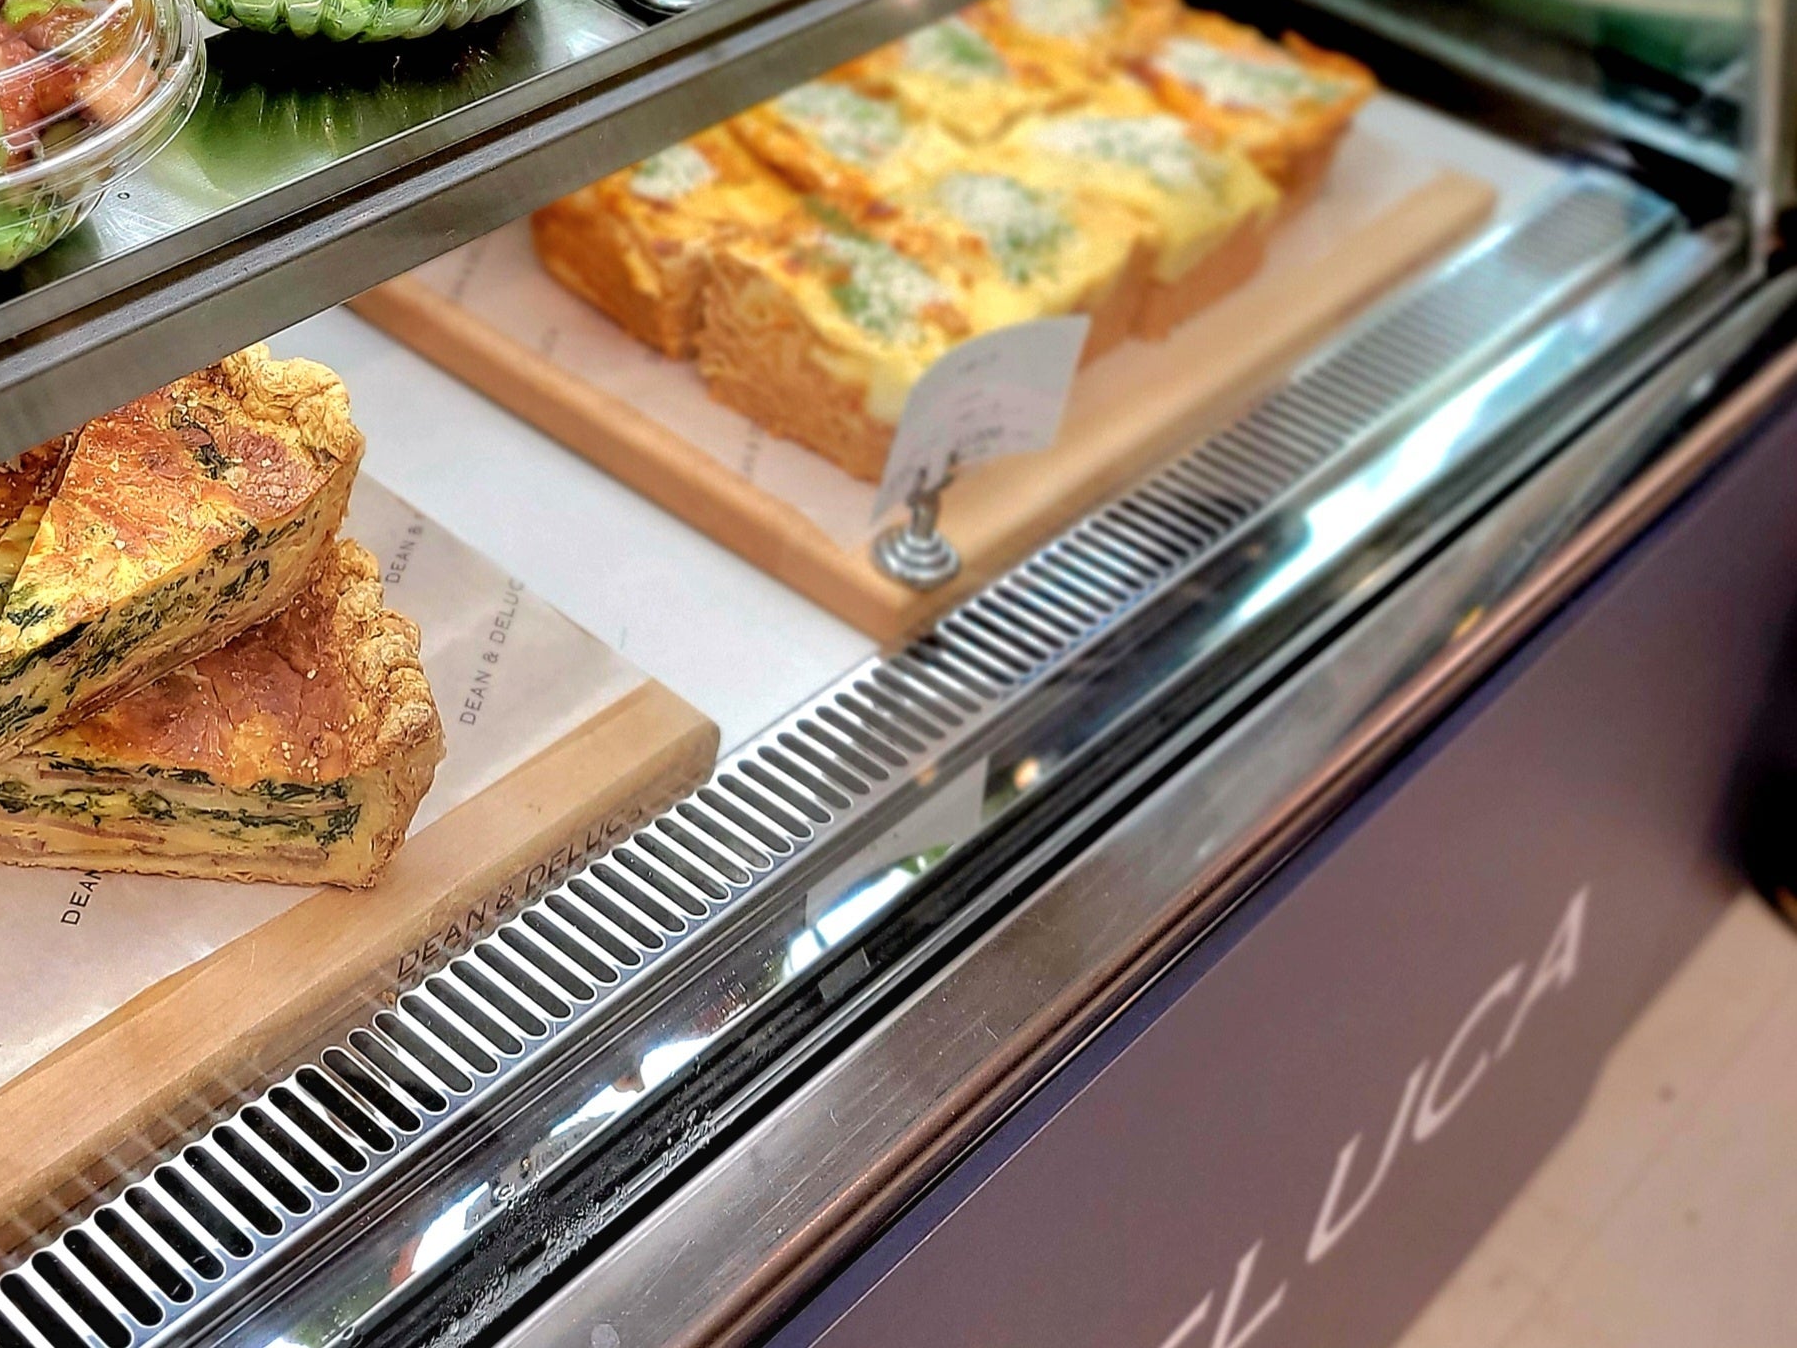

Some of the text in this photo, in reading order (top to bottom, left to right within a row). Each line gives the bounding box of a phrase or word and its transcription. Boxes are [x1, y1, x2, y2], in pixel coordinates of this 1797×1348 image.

[384, 540, 417, 585] DEAN
[459, 577, 526, 727] DEAN & DELUC
[397, 901, 488, 980] DEAN
[1160, 885, 1591, 1348] LUCA
